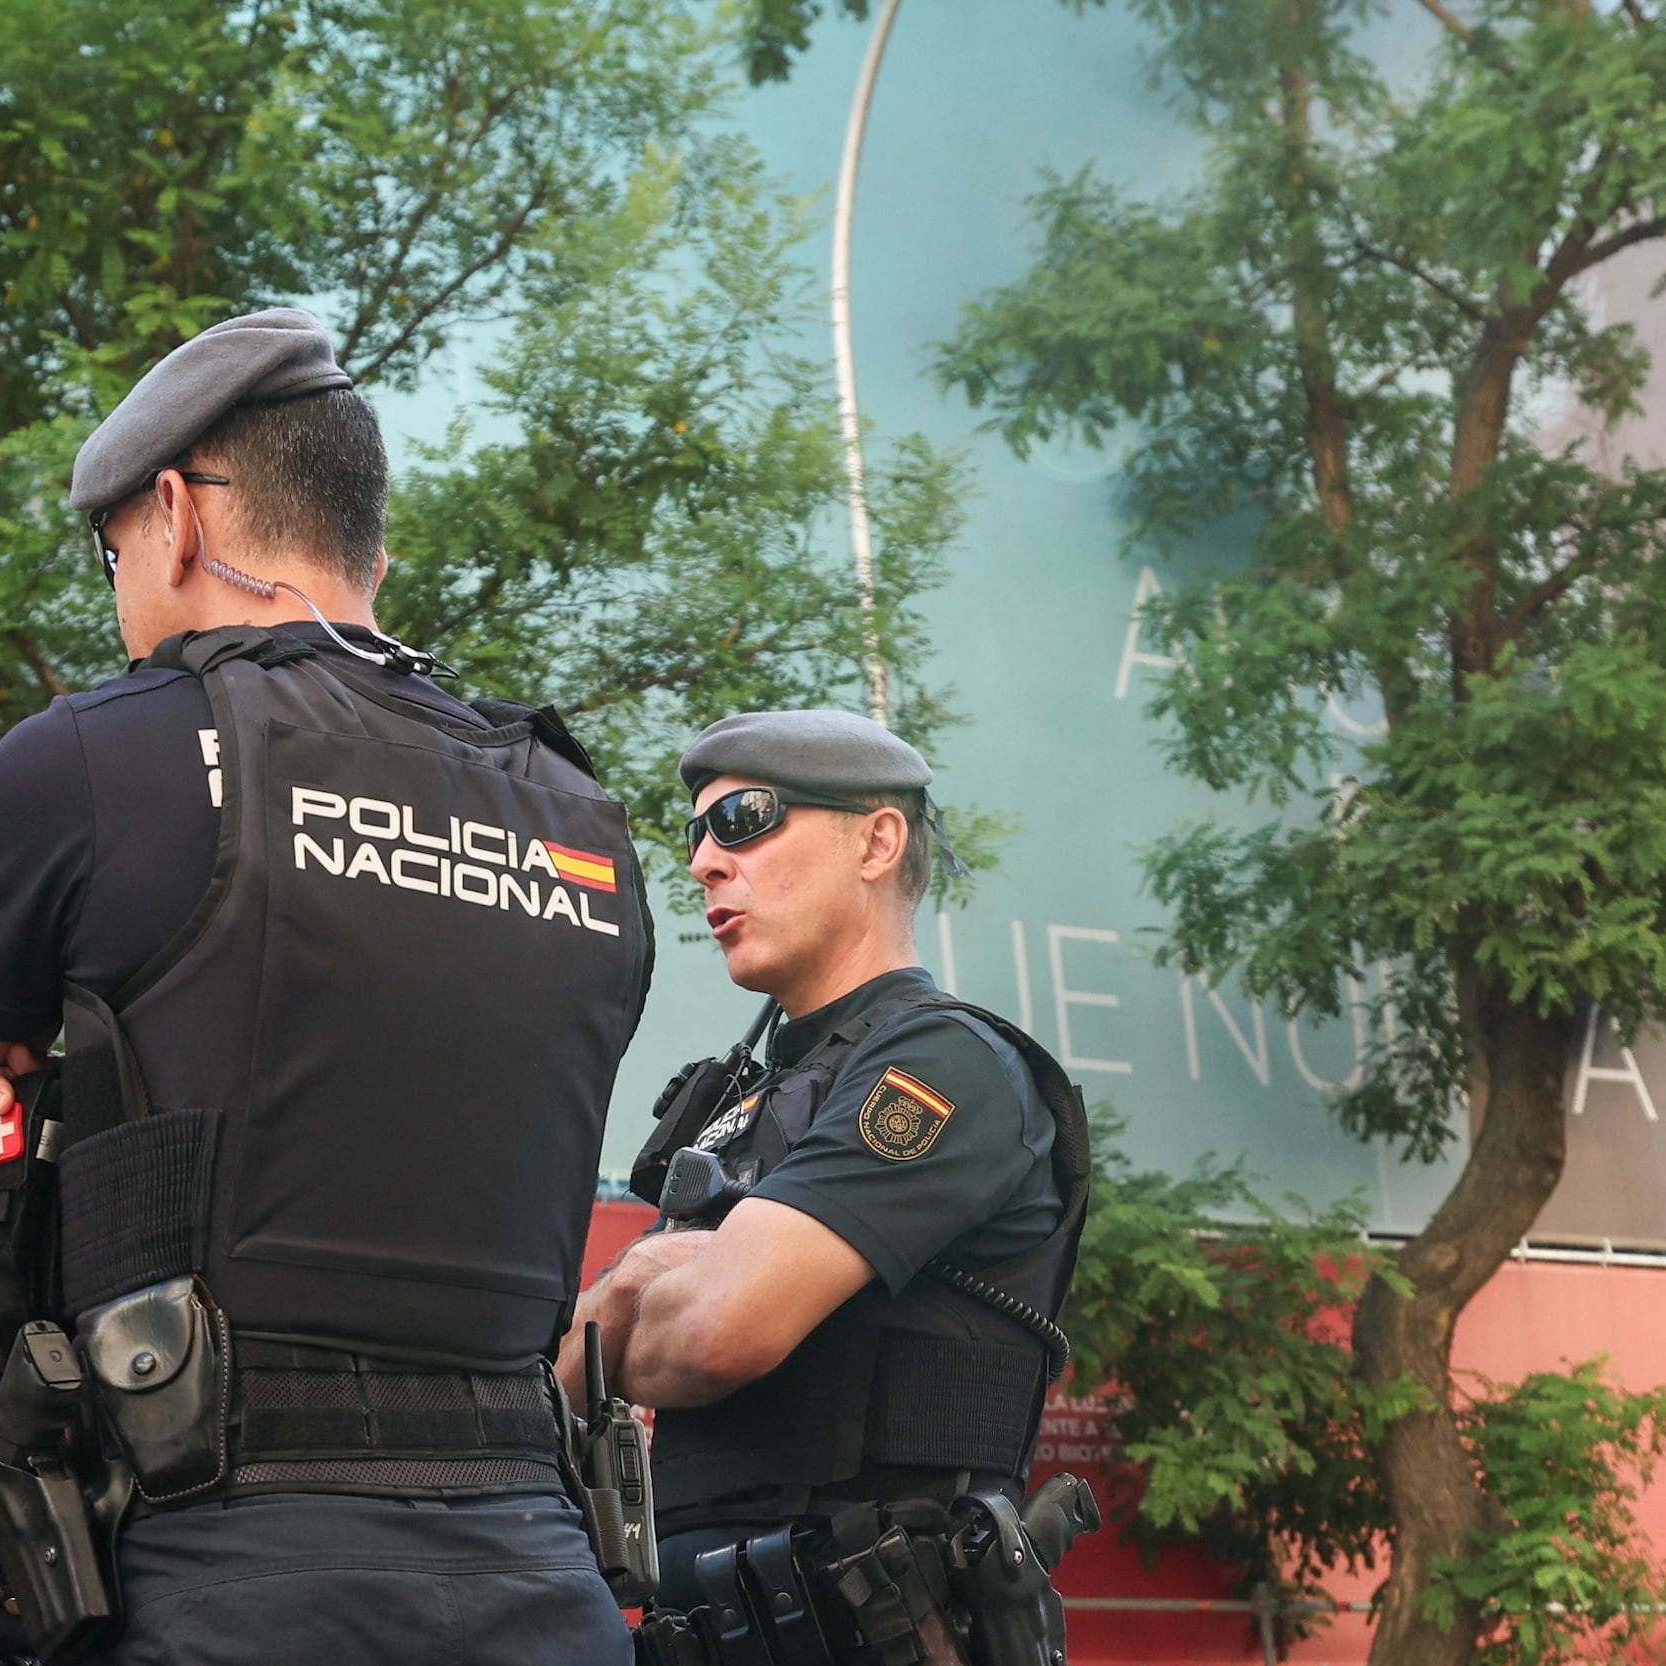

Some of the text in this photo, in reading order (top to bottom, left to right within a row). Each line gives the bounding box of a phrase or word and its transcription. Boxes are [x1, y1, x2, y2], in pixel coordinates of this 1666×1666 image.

[293, 832, 621, 938] NACIONAL
[863, 1085, 887, 1120] CUERPO
[863, 1121, 901, 1156] NACIONAL
[917, 1119, 941, 1151] POLICIA
